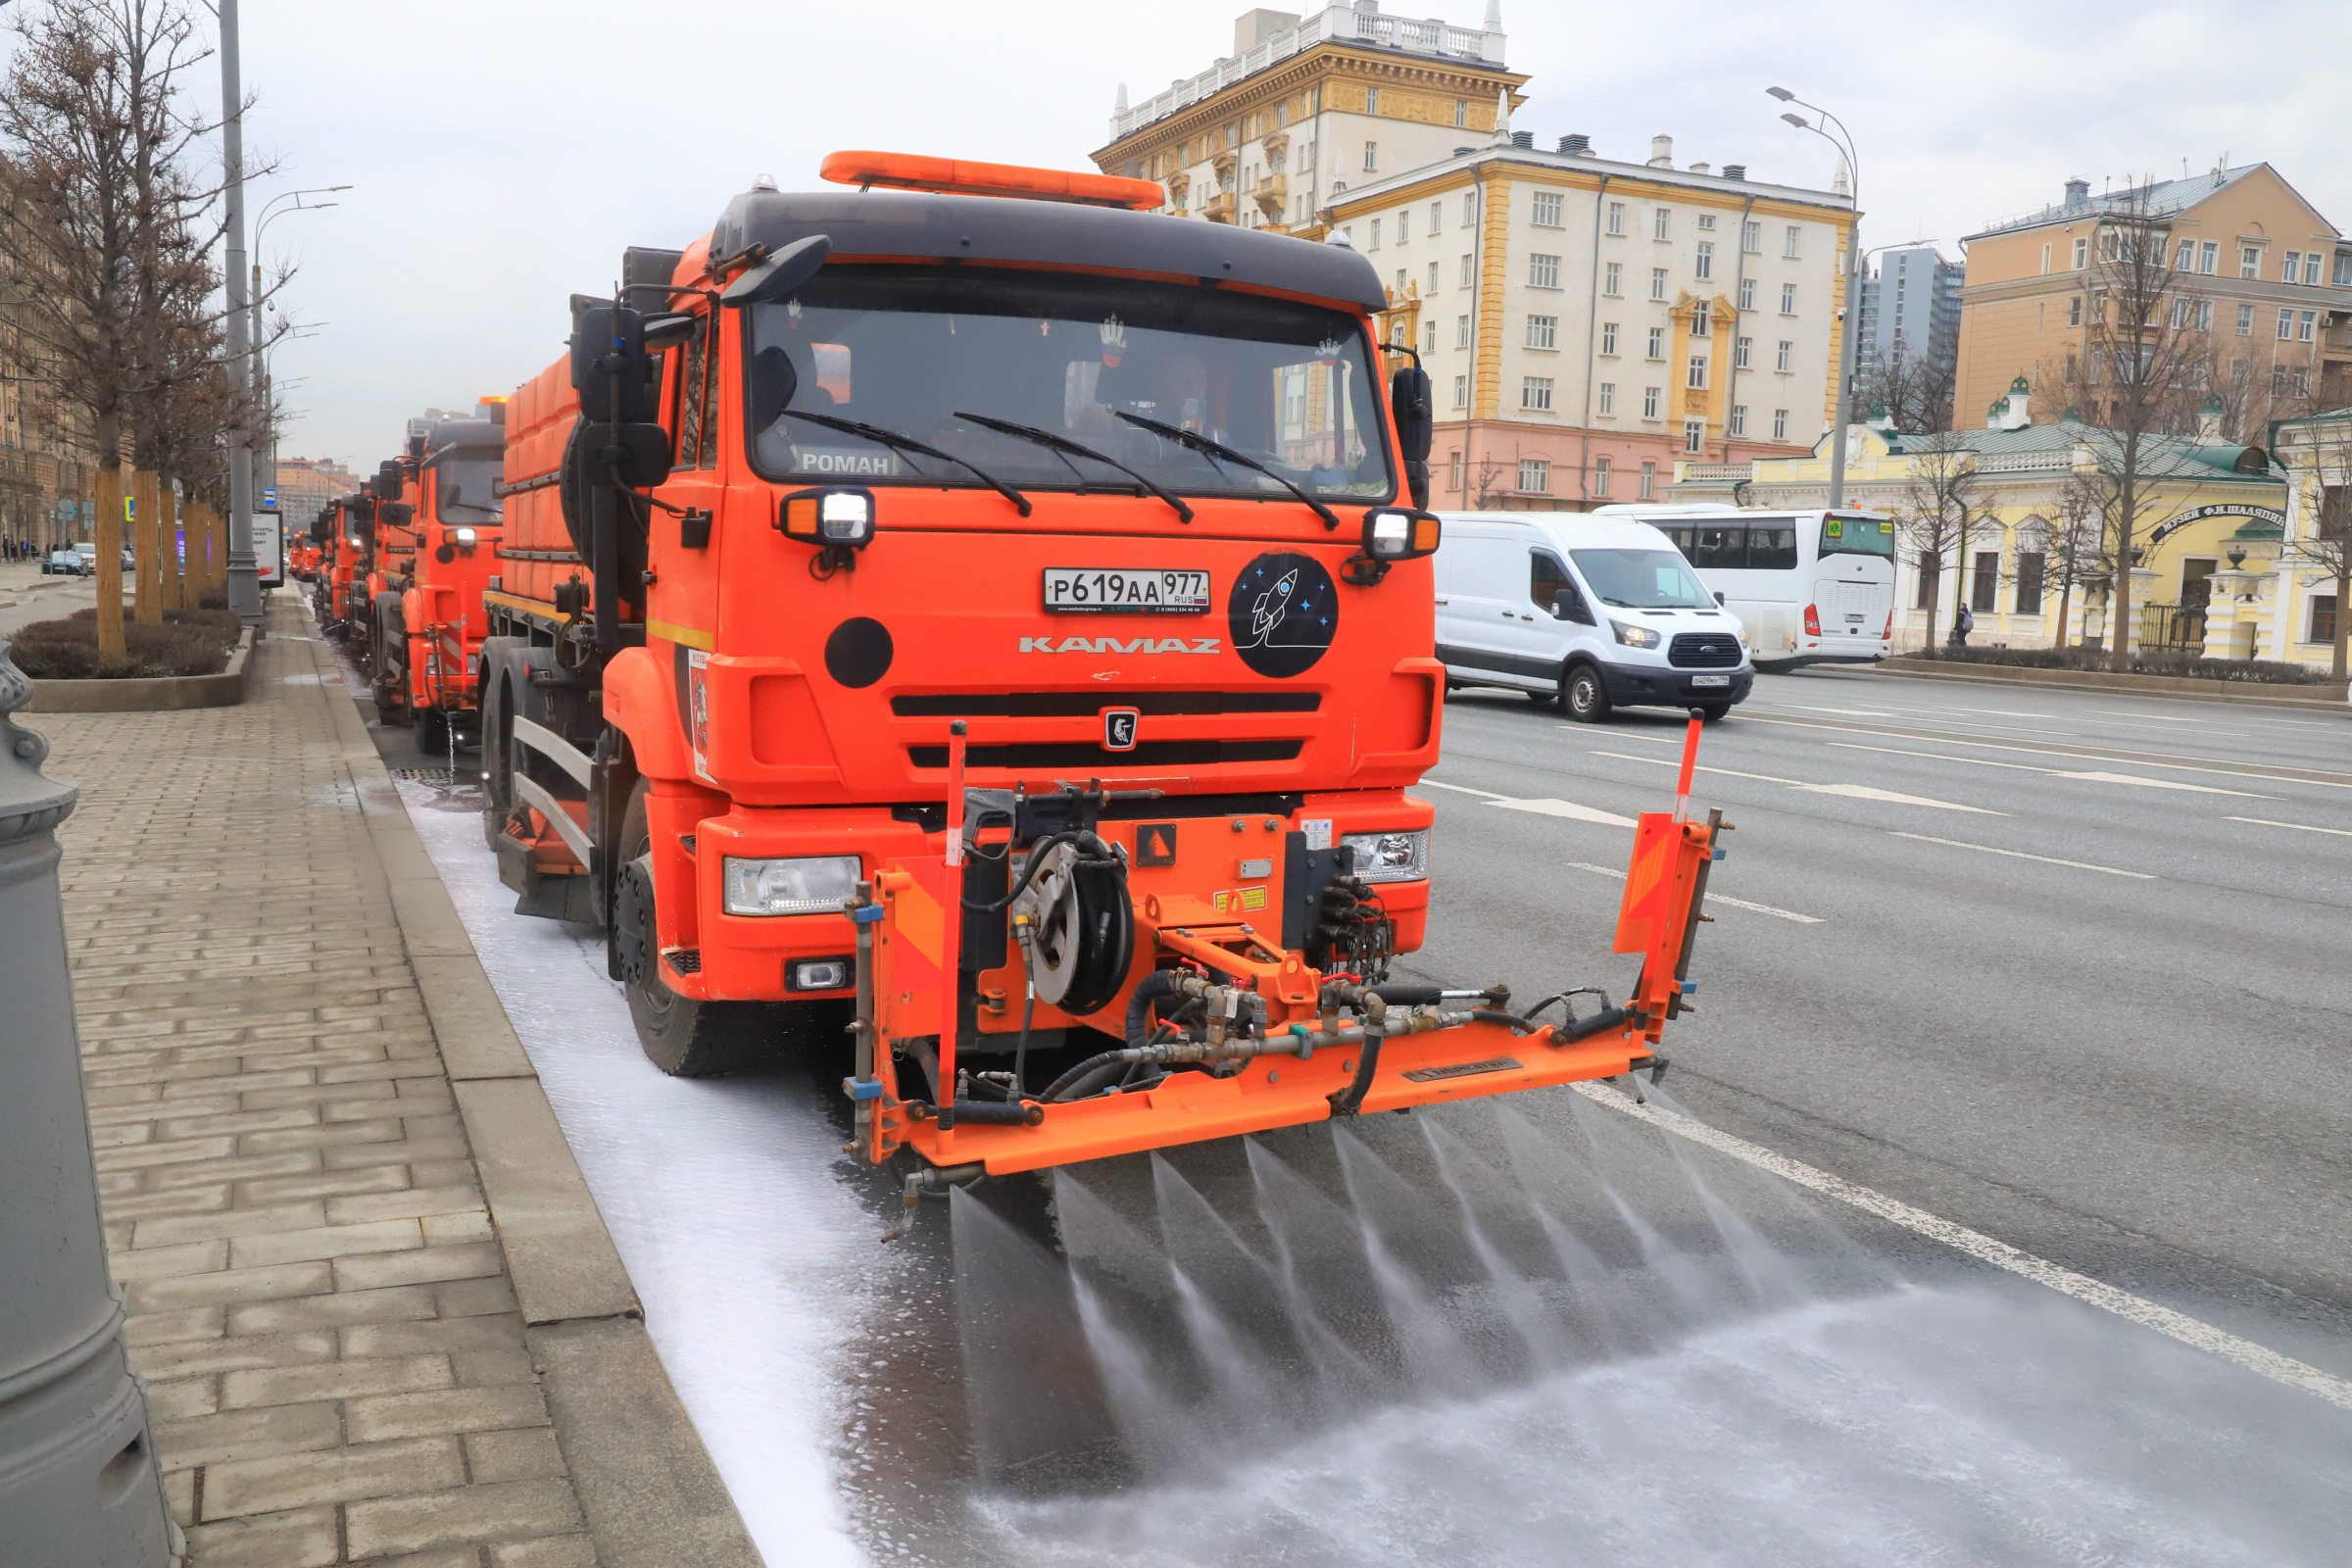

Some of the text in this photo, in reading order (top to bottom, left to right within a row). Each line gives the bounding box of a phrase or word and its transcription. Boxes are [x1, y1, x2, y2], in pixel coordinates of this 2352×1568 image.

[803, 453, 888, 475] РОМАН
[2162, 509, 2201, 532] МУЗЕЙ
[1054, 573, 1202, 603] Р619АА 977
[1018, 636, 1221, 655] KAMAZ
